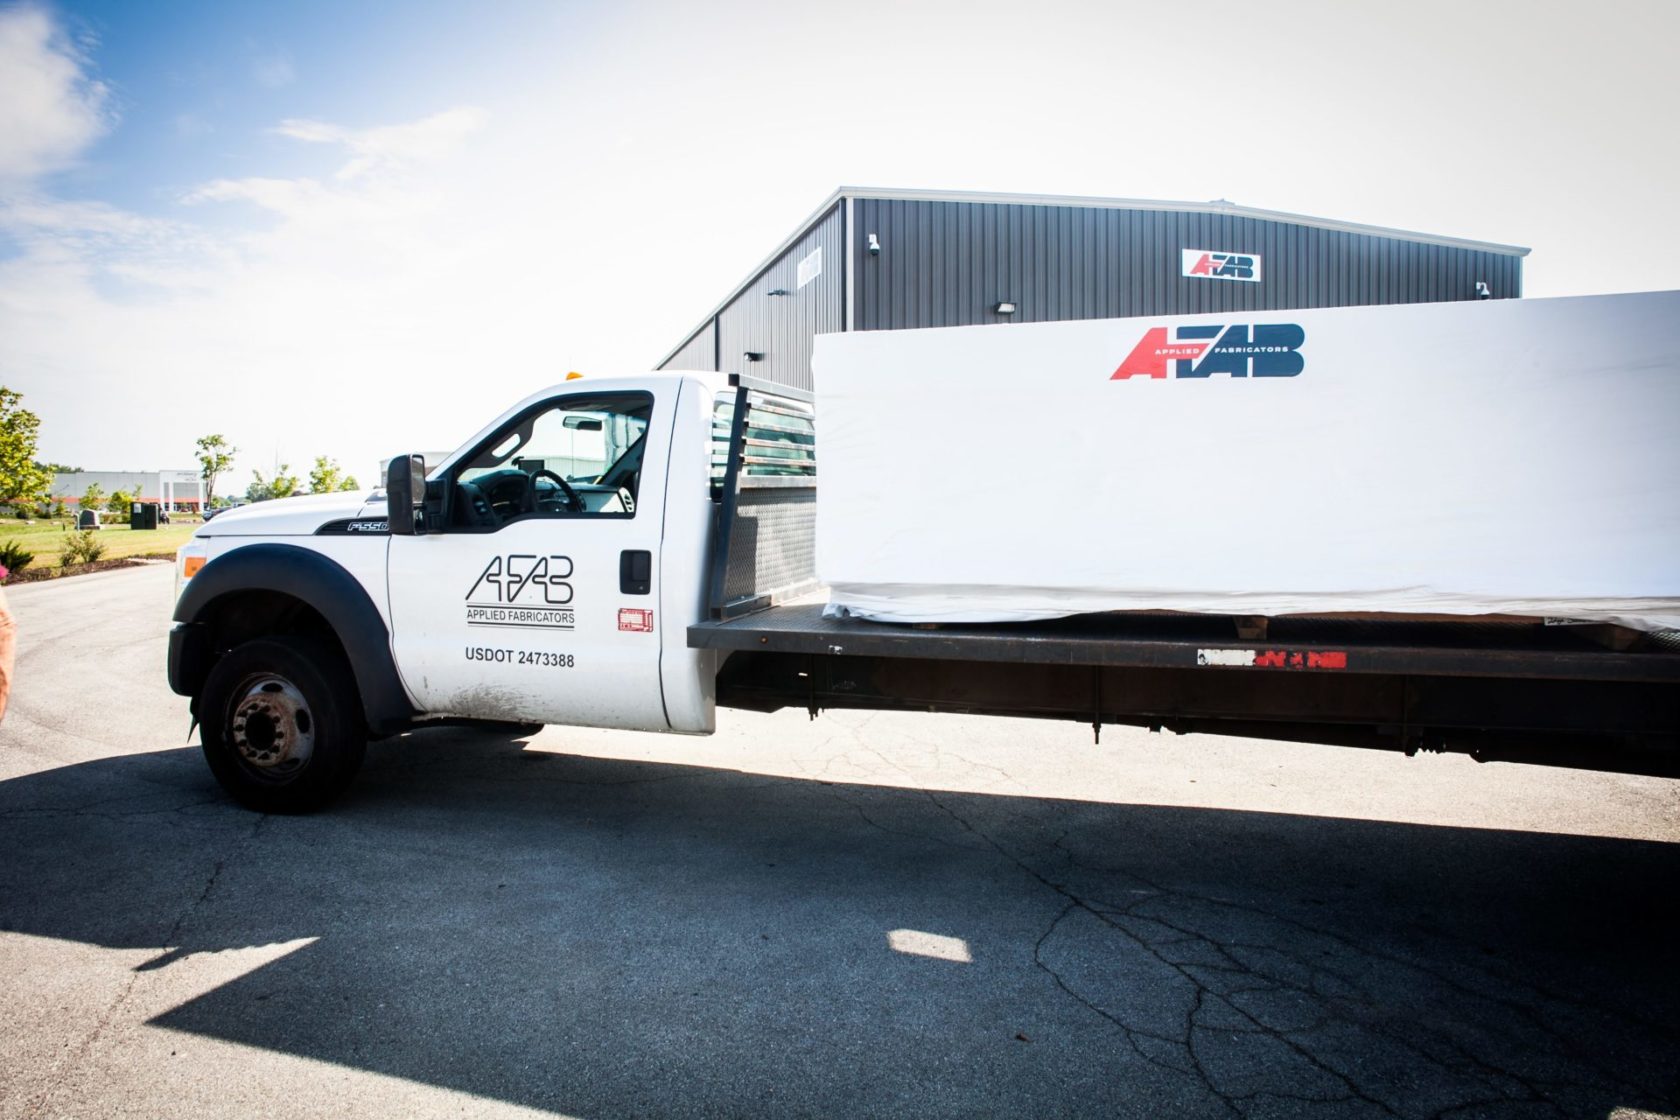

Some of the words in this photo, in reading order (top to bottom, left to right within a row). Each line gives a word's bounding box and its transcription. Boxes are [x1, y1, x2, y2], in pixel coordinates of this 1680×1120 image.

[1190, 254, 1254, 278] AFAB
[1110, 323, 1305, 380] AFAB
[1214, 346, 1289, 354] FABRICATORS
[465, 554, 574, 604] AFAB
[466, 609, 506, 621] APPLIED
[508, 610, 575, 624] FABRICATORS
[465, 646, 514, 663] USDOT
[518, 650, 575, 668] 2473388
